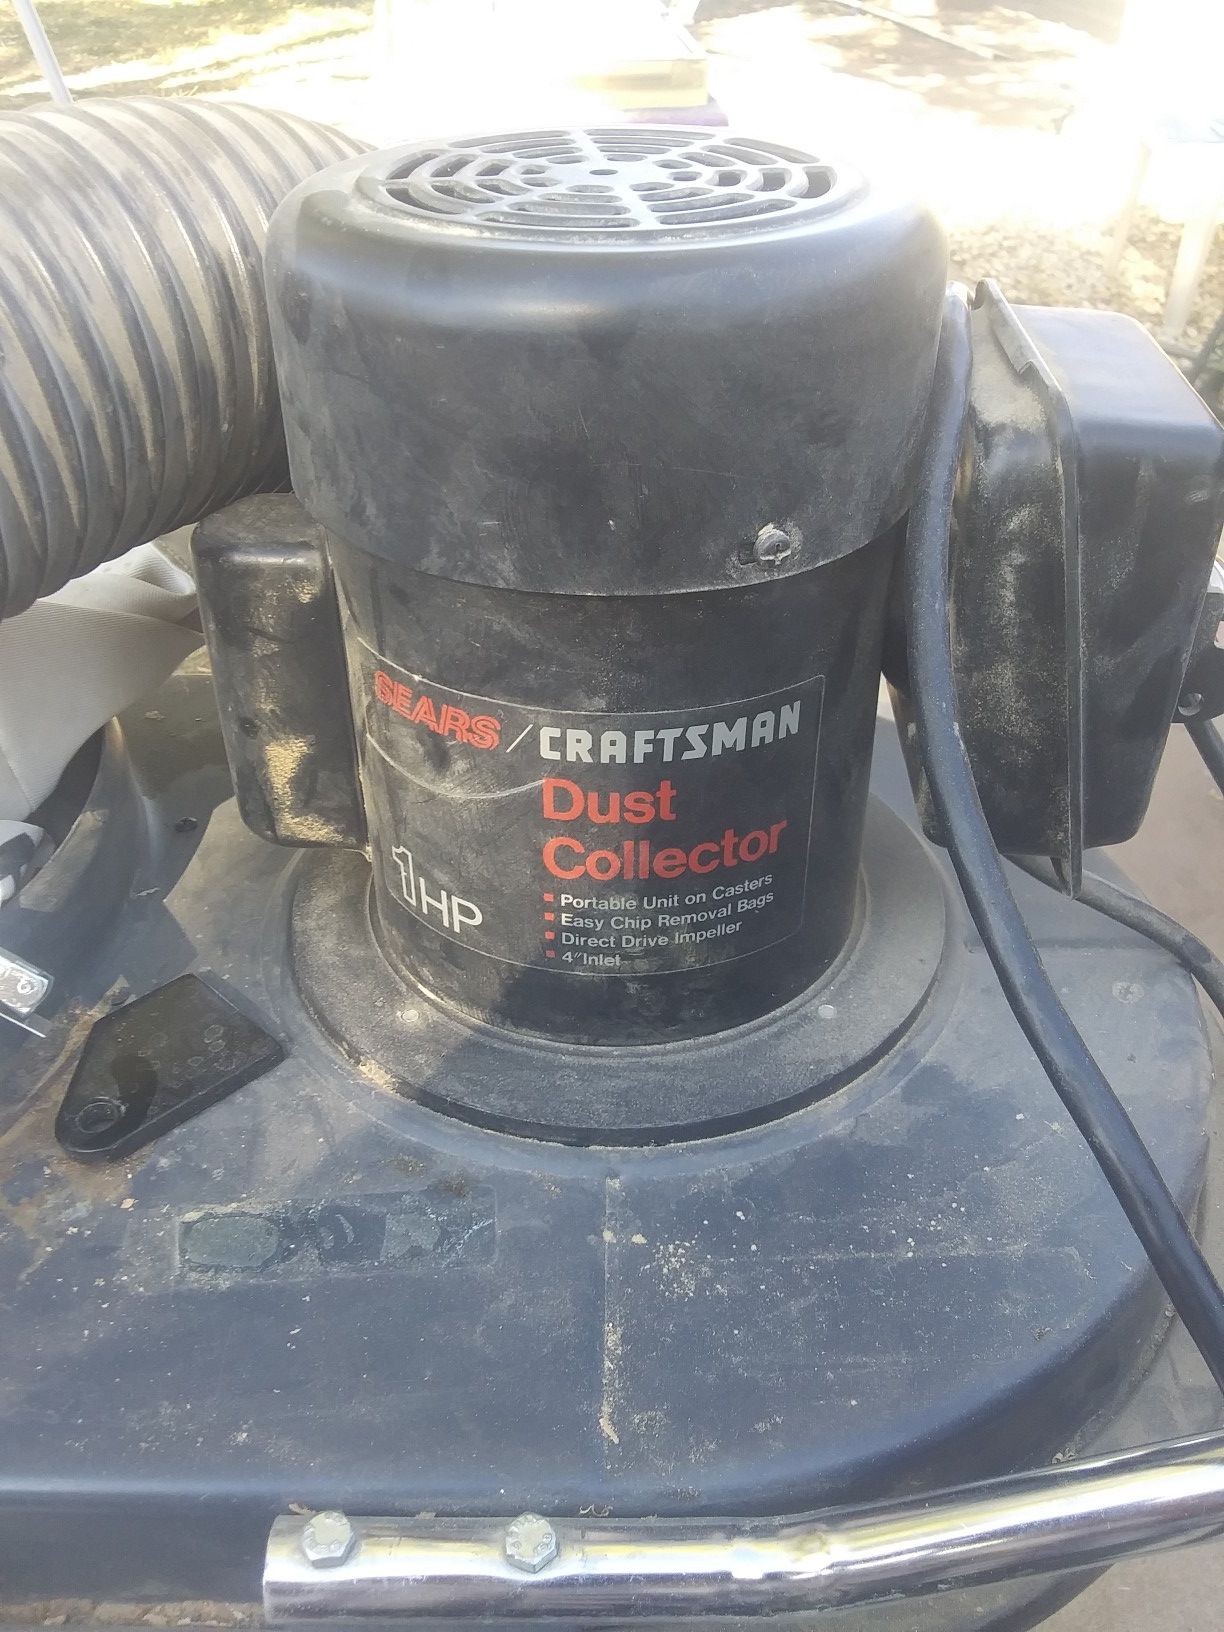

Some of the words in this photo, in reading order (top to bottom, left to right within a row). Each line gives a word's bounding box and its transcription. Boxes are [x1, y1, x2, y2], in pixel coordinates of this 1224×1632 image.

[374, 670, 501, 750] SEARS
[539, 700, 801, 764] CRAFTSMAN
[542, 777, 677, 824] Dust
[542, 820, 787, 881] Collector
[560, 893, 638, 911] Portable
[643, 895, 680, 911] Unit
[684, 893, 707, 904] on
[712, 873, 773, 900] Casters
[560, 912, 604, 931] Easy
[610, 913, 653, 931] Chip
[658, 904, 732, 927] Removal
[737, 891, 774, 912] Bags
[560, 931, 616, 949] Direct
[620, 933, 670, 949] Drive
[674, 920, 743, 944] Impeller
